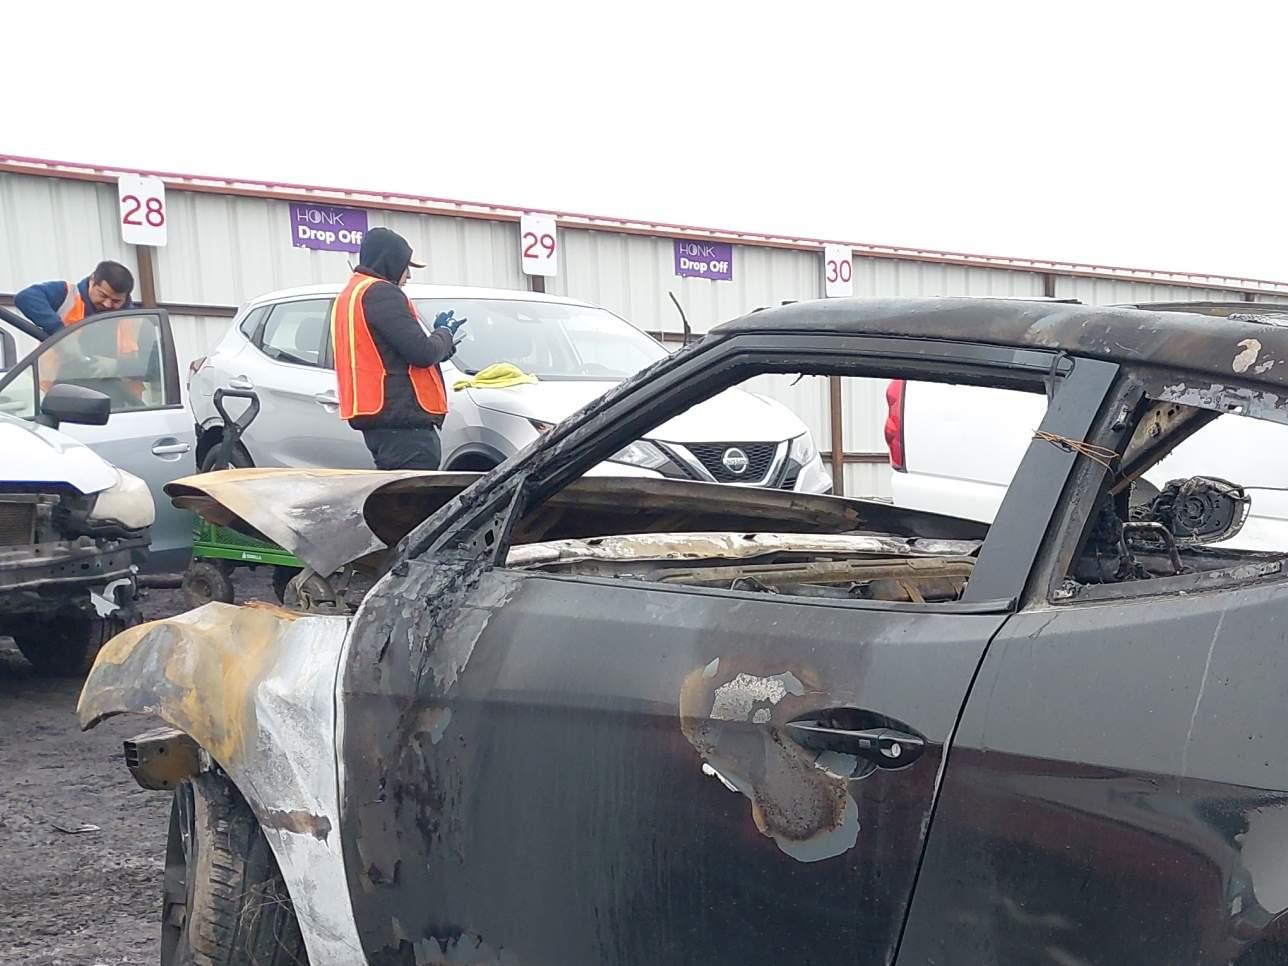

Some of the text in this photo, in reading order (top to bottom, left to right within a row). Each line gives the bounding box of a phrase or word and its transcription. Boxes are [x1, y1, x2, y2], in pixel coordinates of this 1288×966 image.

[121, 195, 165, 227] 28
[296, 207, 345, 226] HONK
[297, 225, 363, 245] Drop Off
[522, 232, 556, 259] 29
[679, 242, 716, 258] HONK
[680, 257, 729, 274] Drop Off
[826, 260, 852, 283] 30
